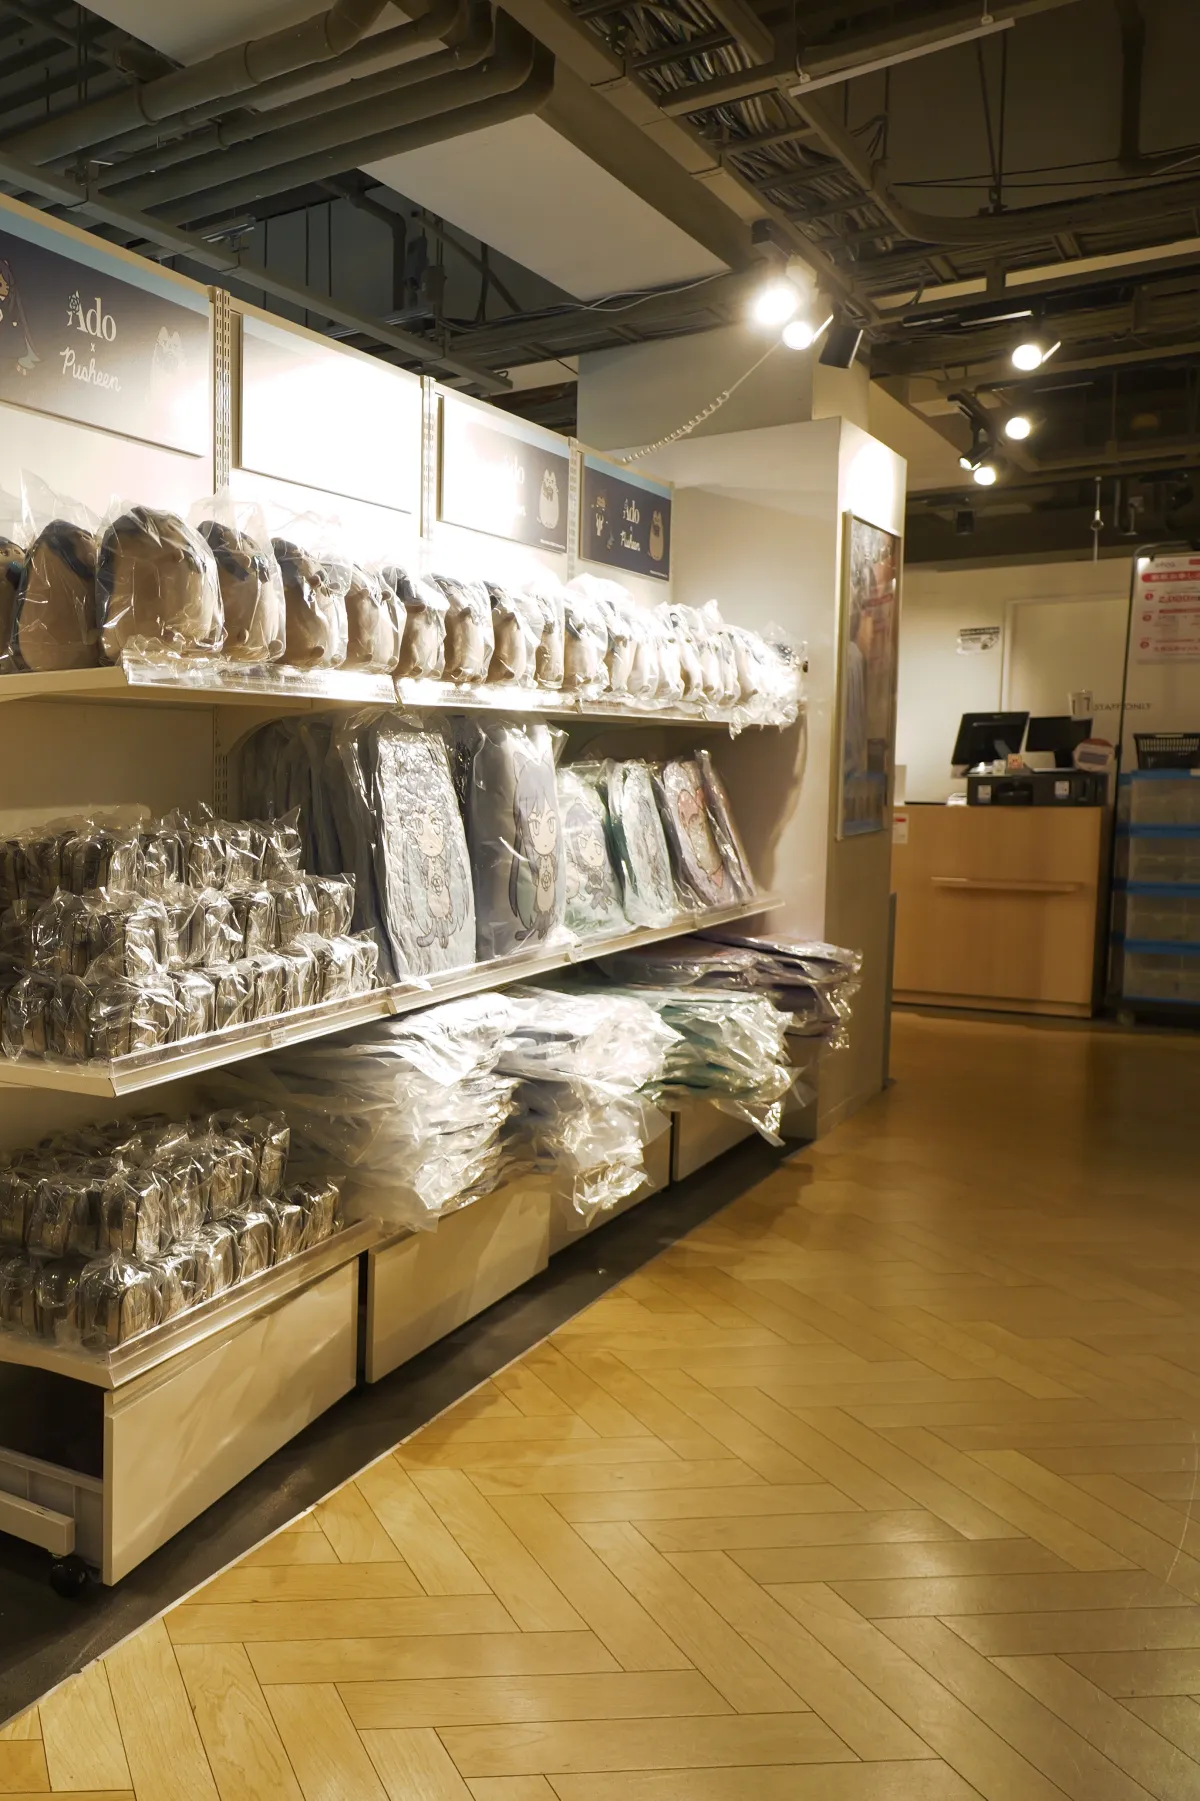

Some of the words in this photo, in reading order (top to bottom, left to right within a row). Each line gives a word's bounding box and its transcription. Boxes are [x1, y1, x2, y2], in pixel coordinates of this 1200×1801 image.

[66, 290, 117, 341] Ado
[60, 347, 121, 392] Pusheen
[622, 498, 640, 525] Ado
[1094, 702, 1121, 711] STAFF
